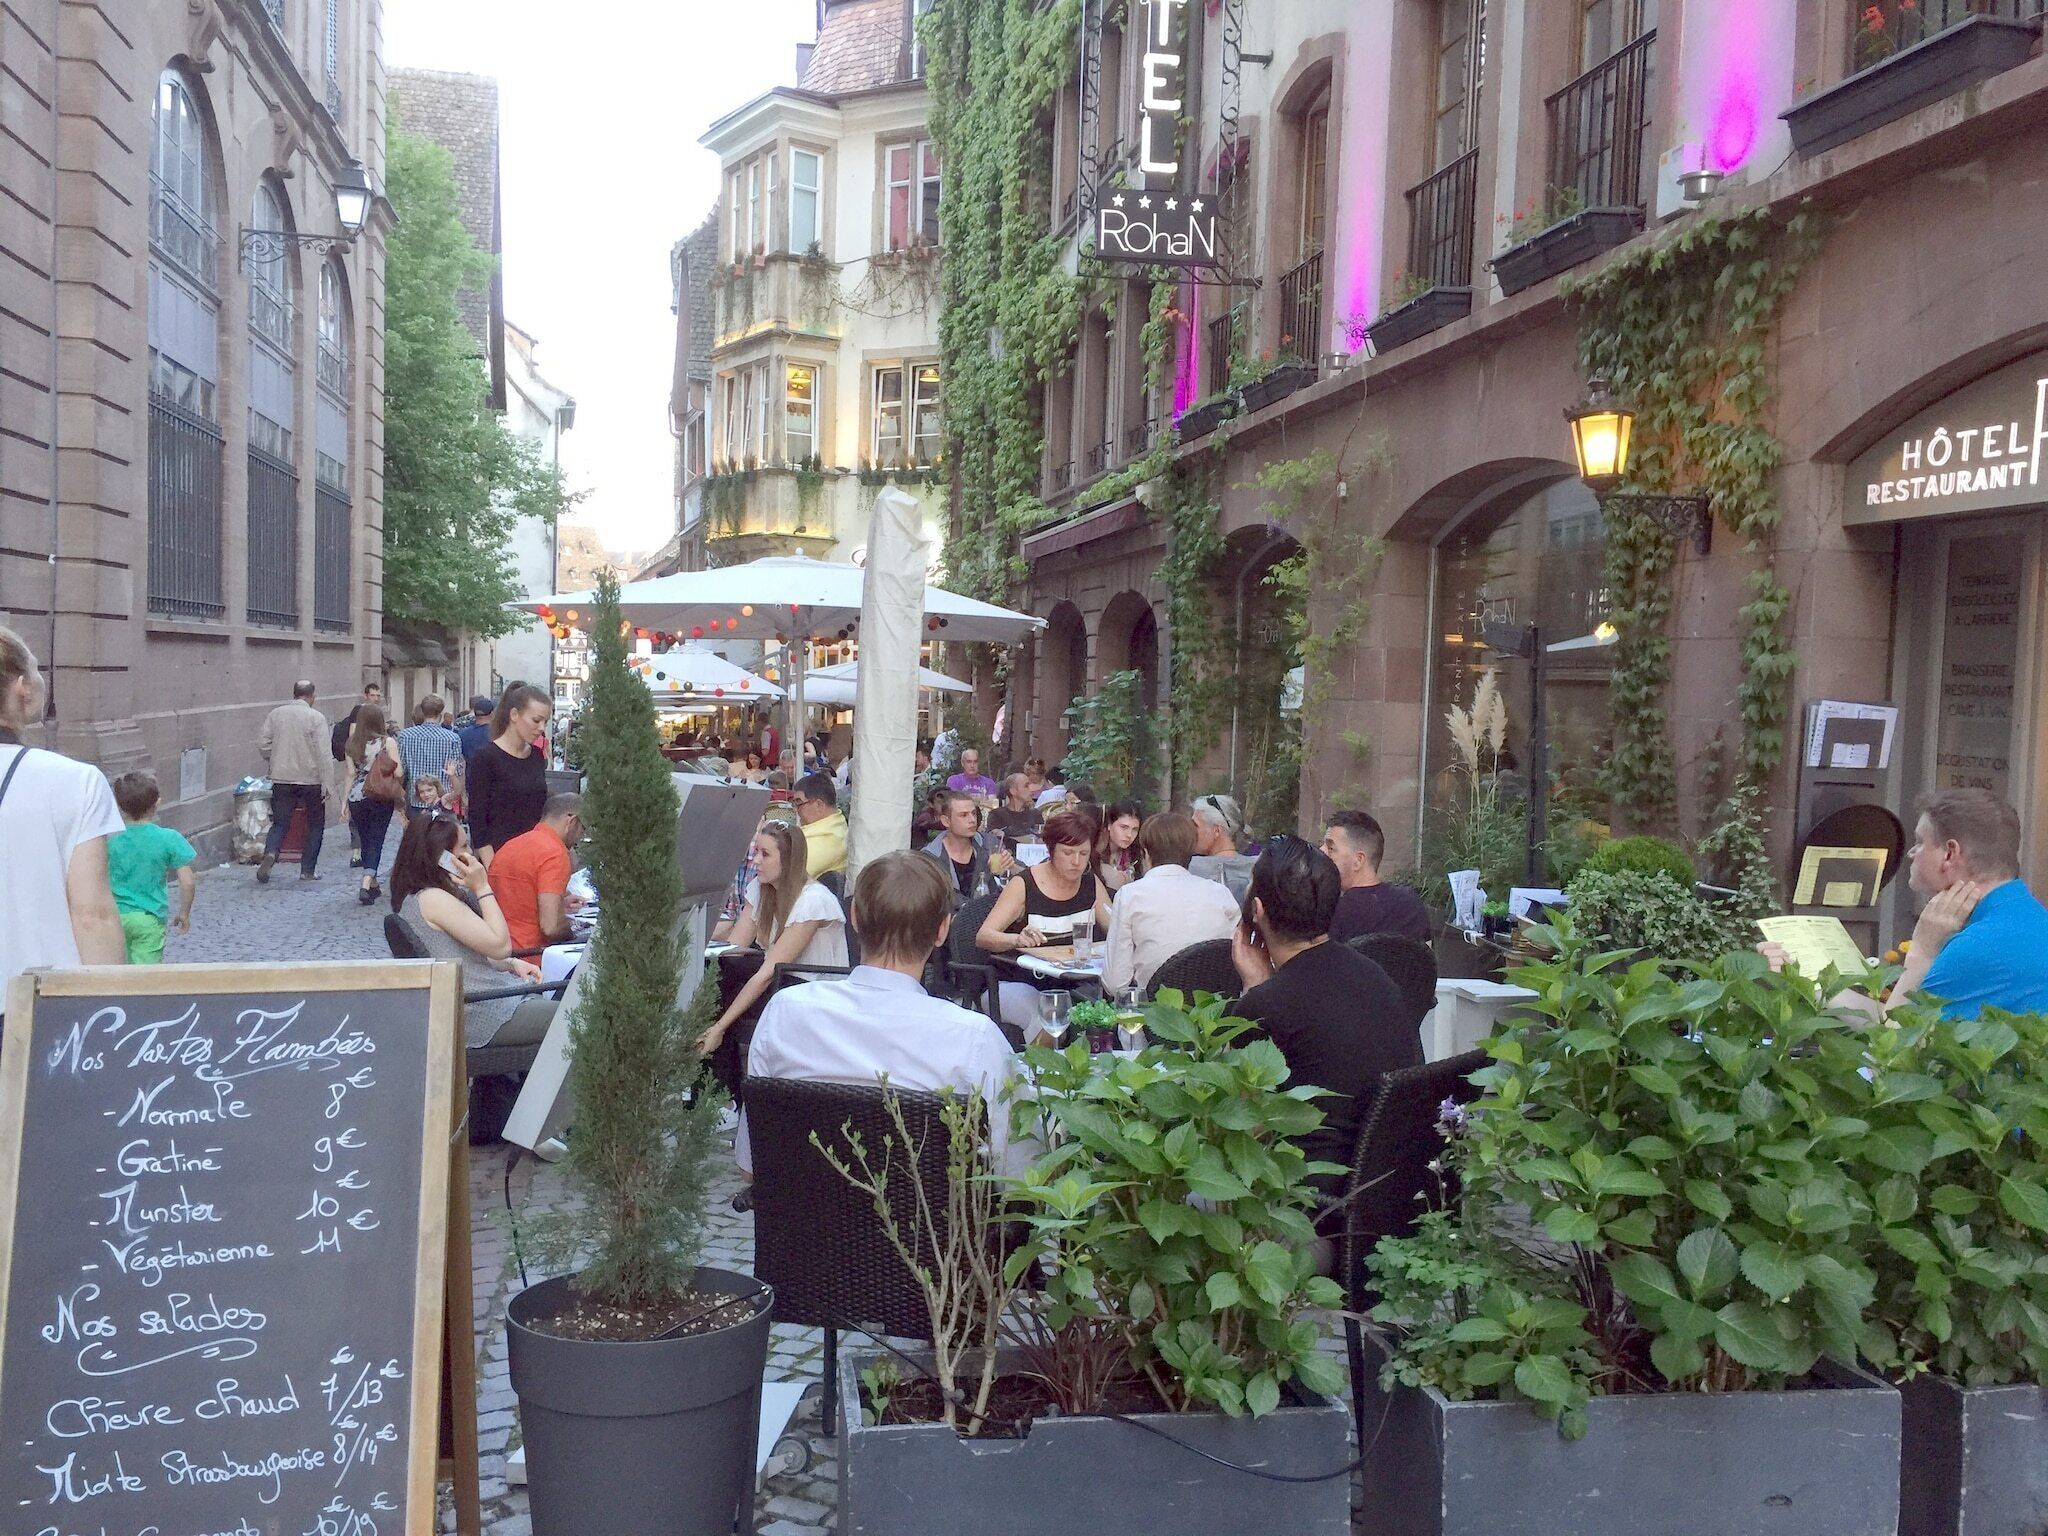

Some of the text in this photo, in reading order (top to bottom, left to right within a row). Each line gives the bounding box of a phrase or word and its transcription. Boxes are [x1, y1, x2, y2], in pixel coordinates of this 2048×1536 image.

[1902, 422, 2029, 471] HÔTEL
[1866, 461, 2028, 505] RESTAURANT
[1450, 656, 1462, 773] RESRANT
[49, 1005, 127, 1075] Nos
[113, 1002, 214, 1068] Tartes
[41, 1283, 117, 1344] Nos
